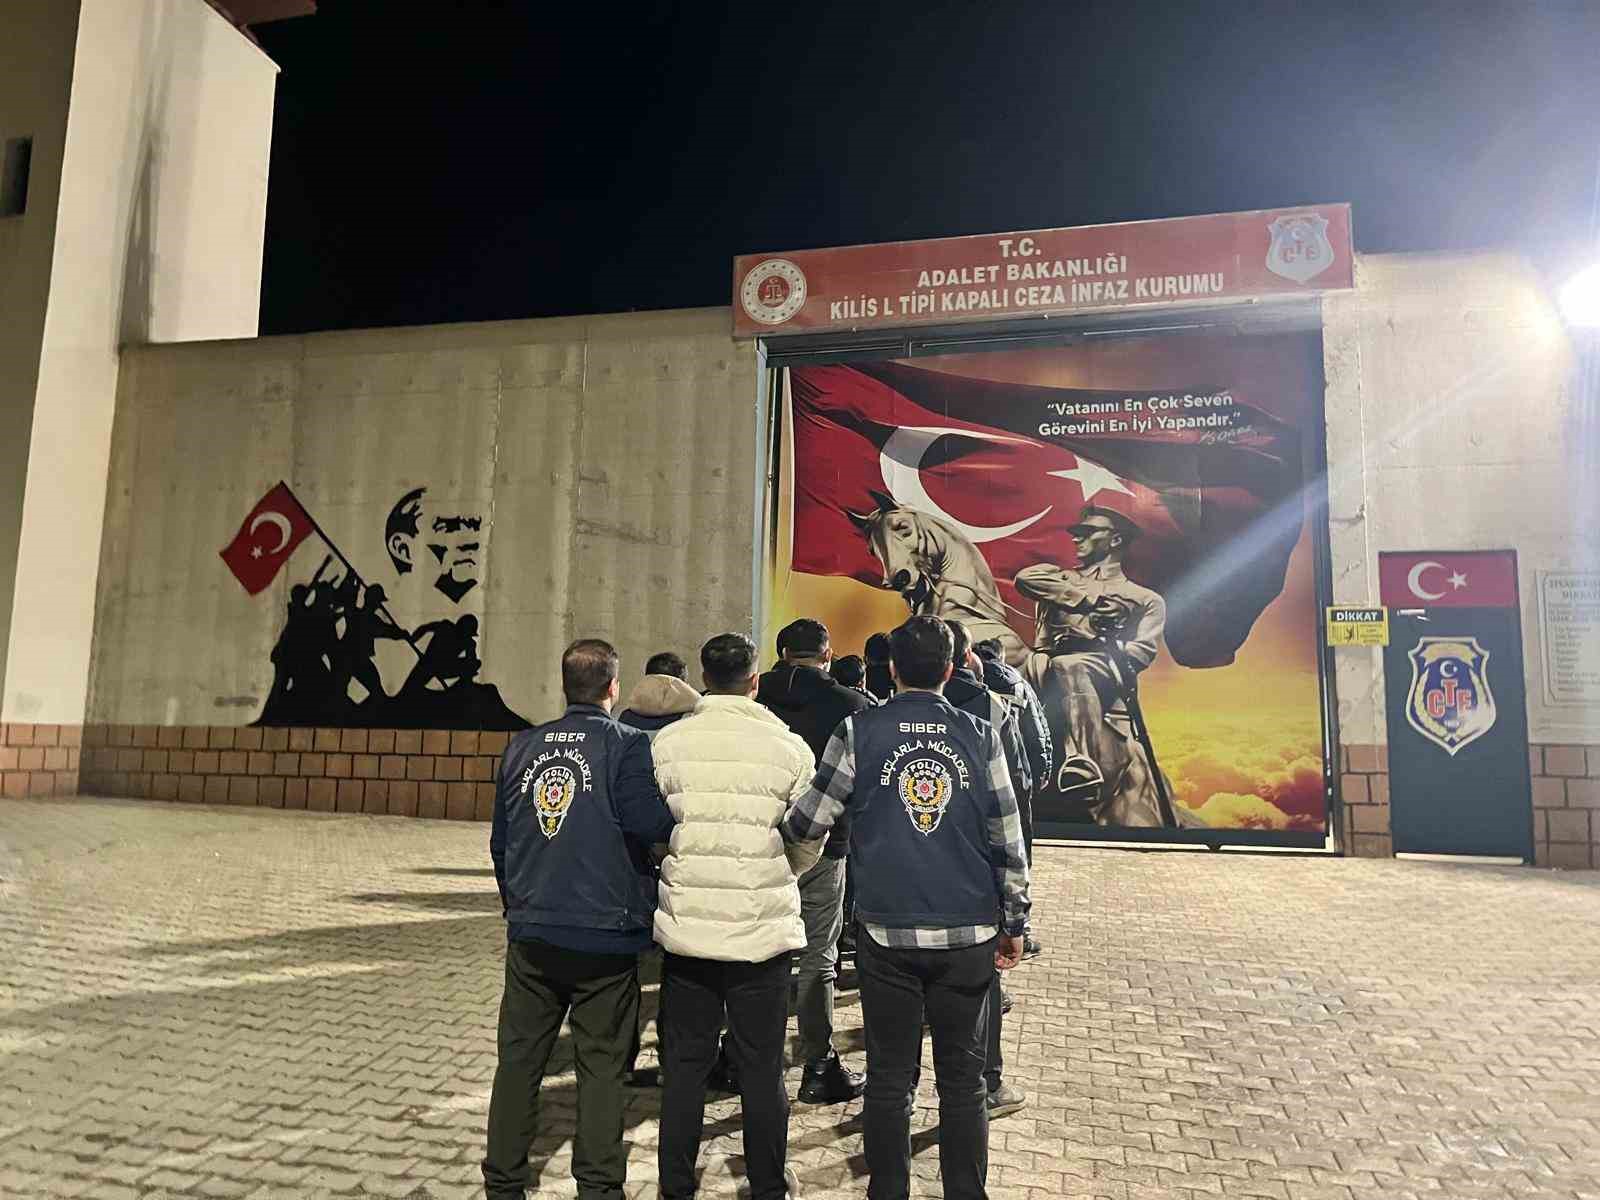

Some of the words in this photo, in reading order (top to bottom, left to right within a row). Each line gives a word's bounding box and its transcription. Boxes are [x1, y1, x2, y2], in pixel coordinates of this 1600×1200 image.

[999, 237, 1041, 258] T.C.
[917, 265, 1000, 287] ADALET
[1007, 252, 1127, 281] BAKANLIĞI
[830, 294, 878, 319] KİLİS
[883, 298, 893, 316] L
[900, 290, 936, 315] TİPİ
[941, 288, 1008, 311] KAPALI
[1014, 284, 1065, 307] CEZA
[1071, 279, 1129, 304] İNFAZ
[1135, 272, 1224, 298] KURUMU
[1124, 399, 1142, 411] En
[1147, 396, 1179, 414] Çok
[1183, 394, 1233, 408] Seven
[1038, 420, 1105, 436] Görevini
[1109, 419, 1128, 432] En
[1133, 414, 1152, 433] İyi
[1336, 610, 1378, 621] DİKKAT
[563, 748, 593, 793] MÜCADELE
[928, 740, 970, 790] MÜCADELE
